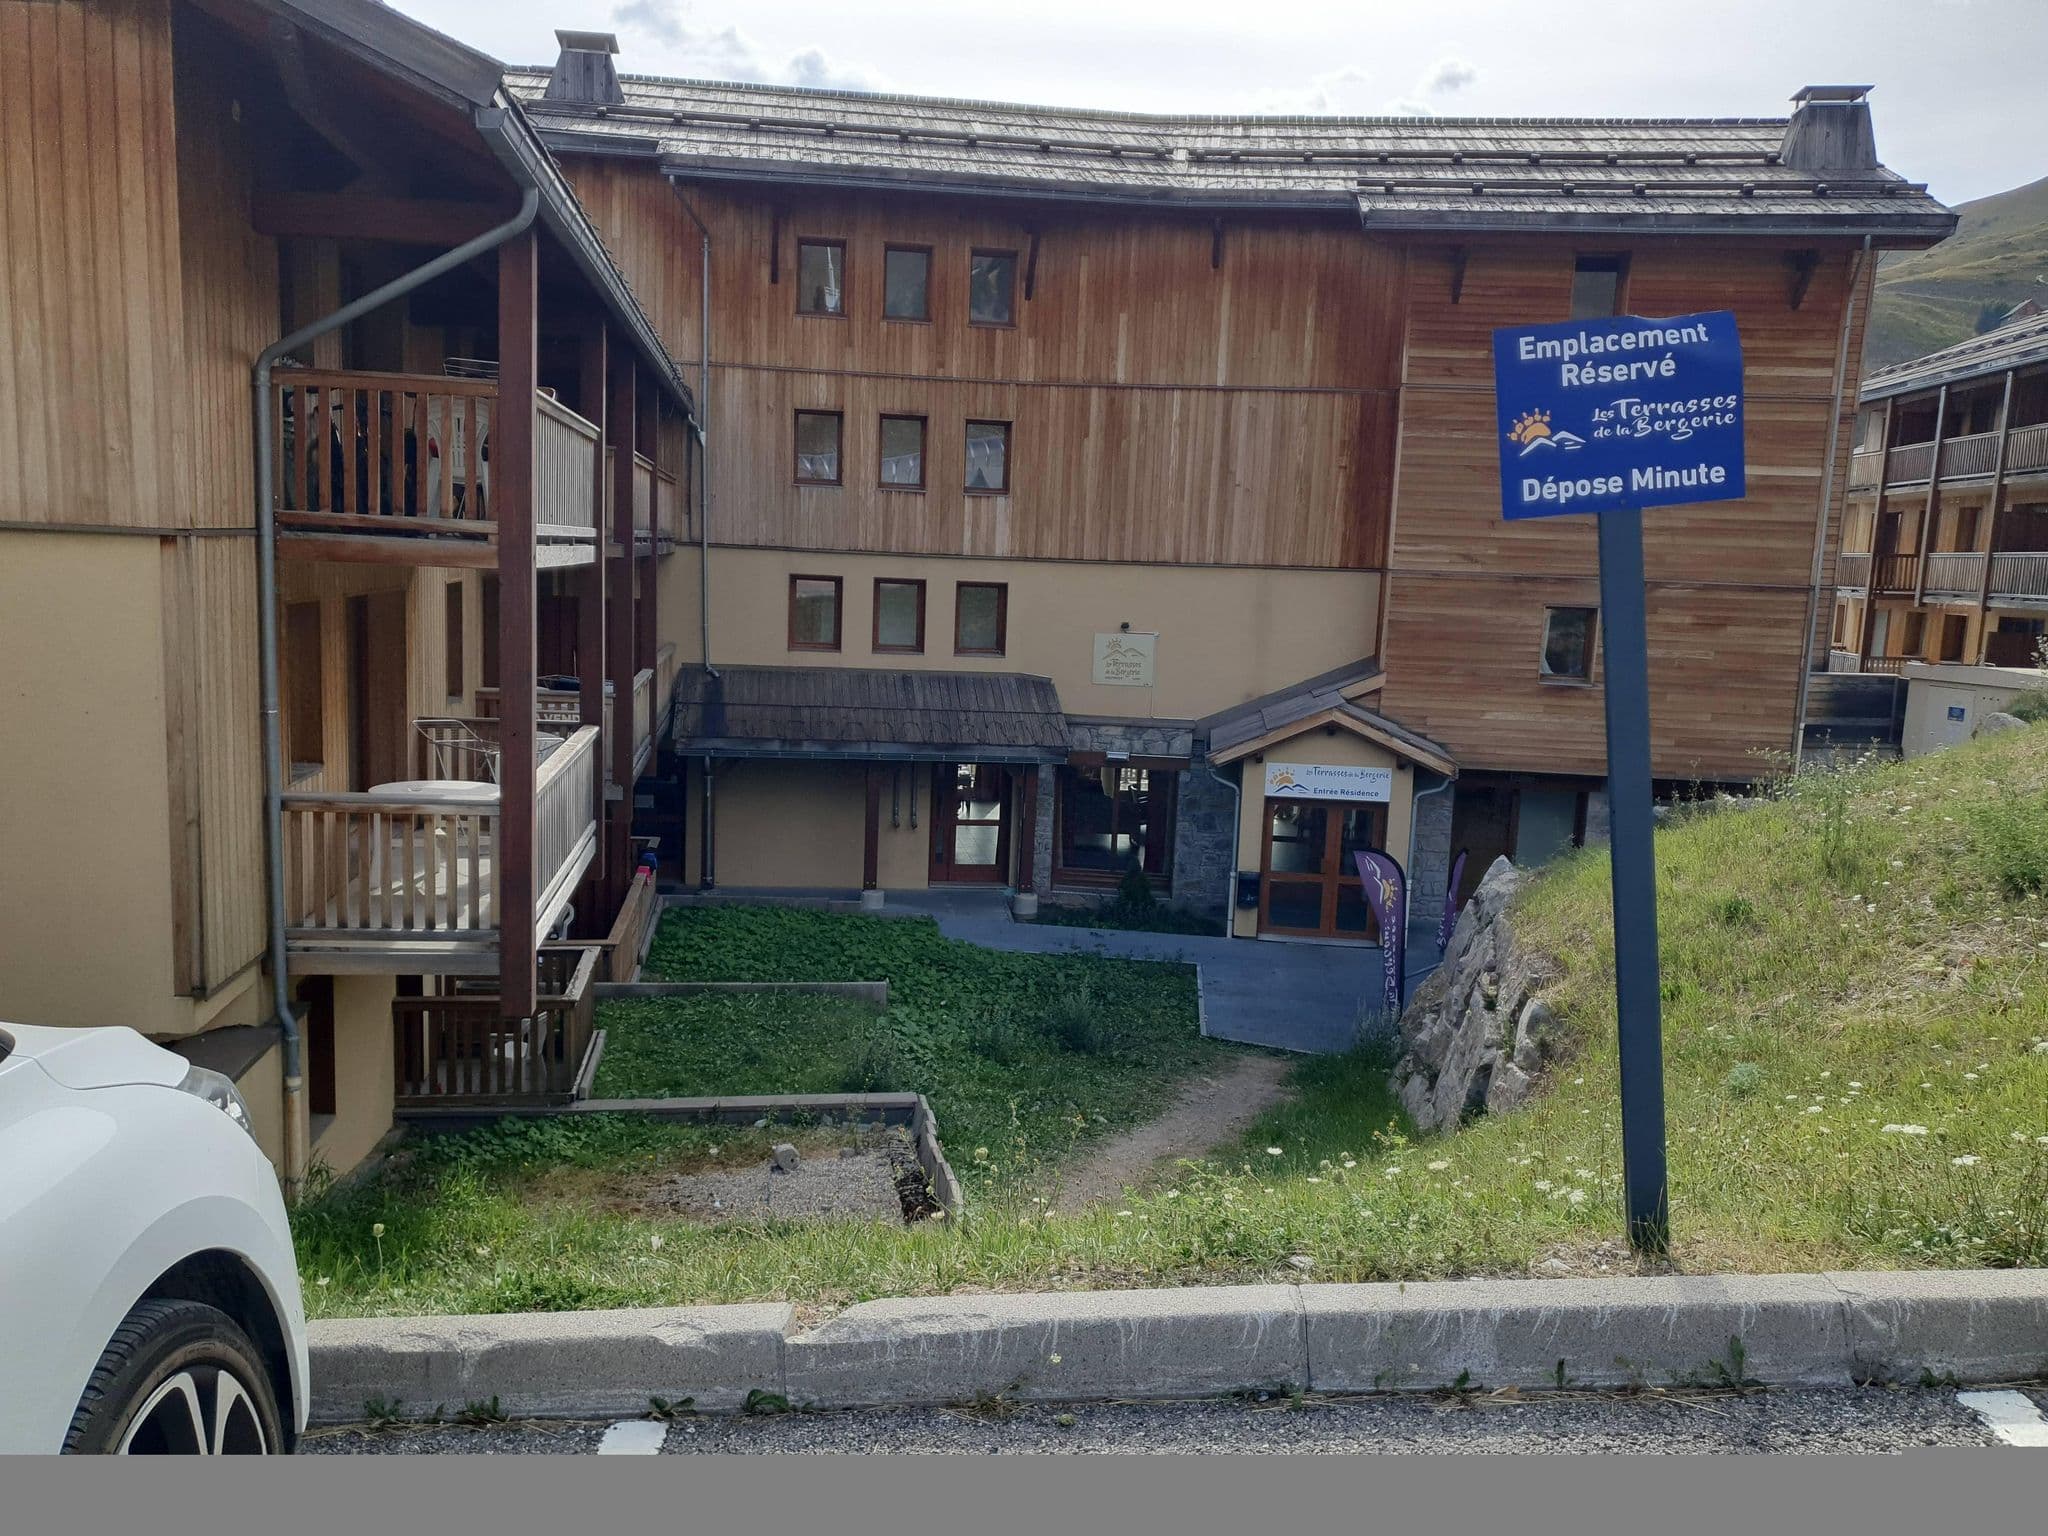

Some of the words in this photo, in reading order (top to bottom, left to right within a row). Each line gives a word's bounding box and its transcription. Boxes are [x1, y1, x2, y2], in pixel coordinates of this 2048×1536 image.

[1519, 323, 1708, 361] Emplacement
[1561, 352, 1676, 387] Réservé
[1610, 394, 1737, 419] Terrasses
[1594, 427, 1612, 438] de
[1616, 425, 1632, 435] la
[1633, 411, 1737, 440] Bergerie
[1522, 475, 1624, 504] Dépose
[1631, 463, 1726, 491] Minute
[1313, 766, 1348, 778] Terrasses
[1360, 770, 1390, 783] Bergerie
[1313, 787, 1338, 796] Entrée
[1340, 788, 1380, 797] Résidence
